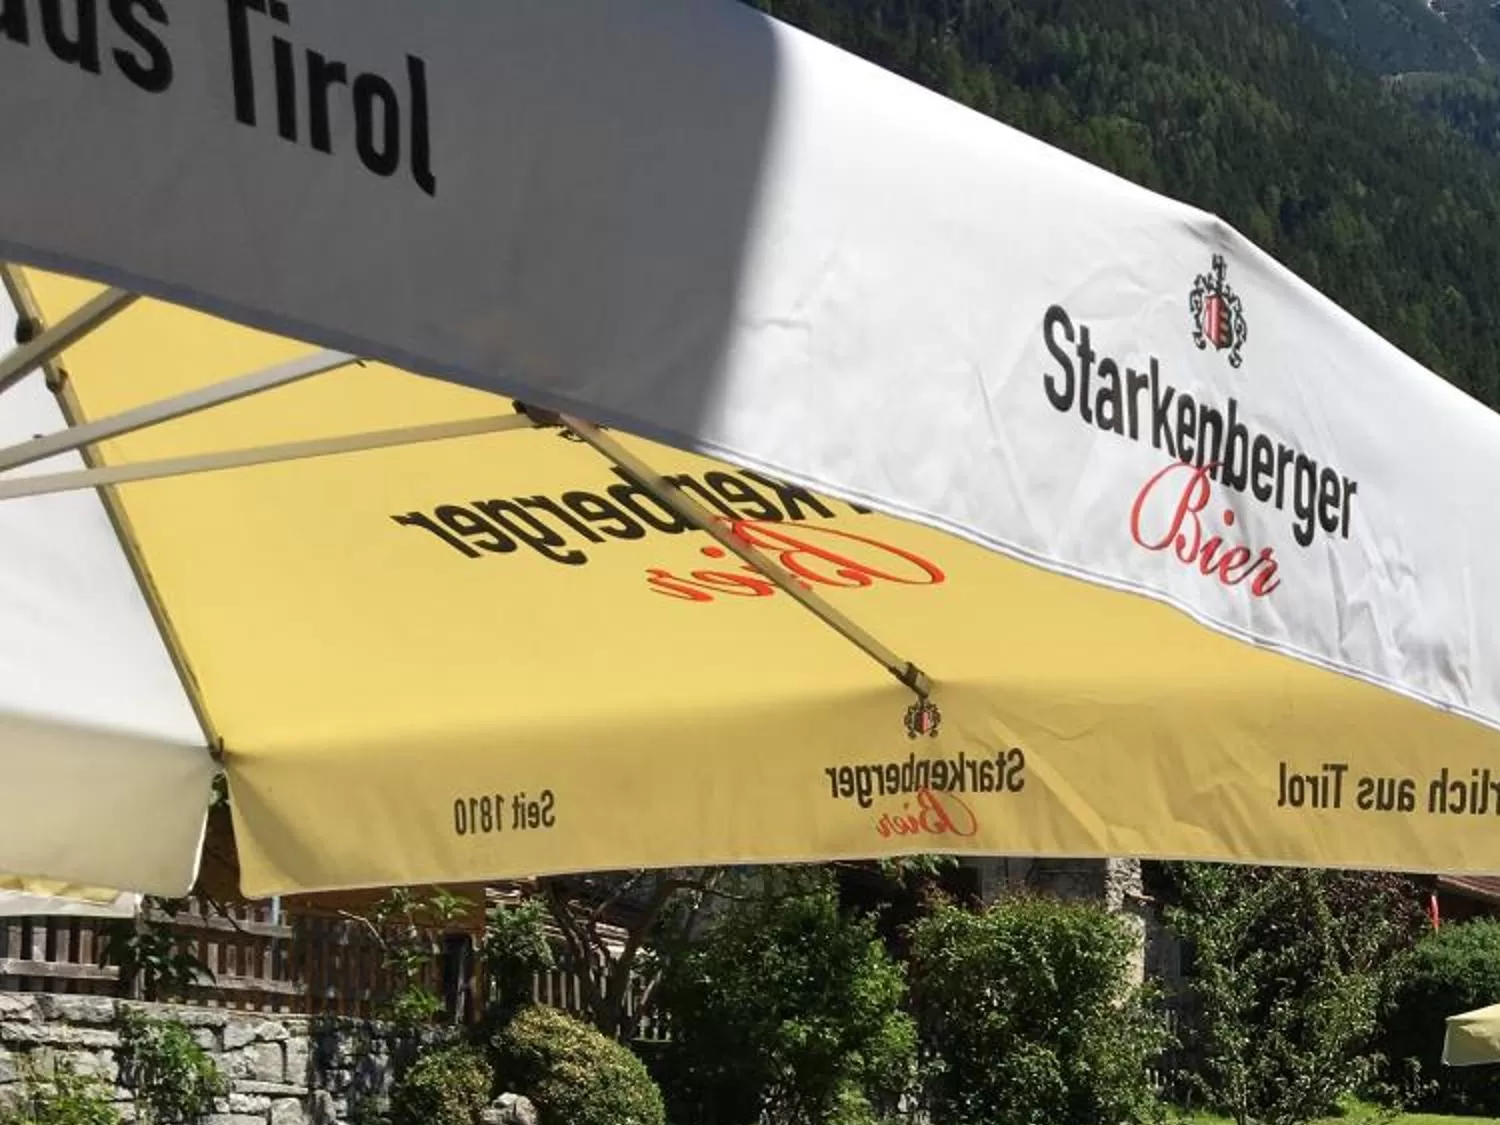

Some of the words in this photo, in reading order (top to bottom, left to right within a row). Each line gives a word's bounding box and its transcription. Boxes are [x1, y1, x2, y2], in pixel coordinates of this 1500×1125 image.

[226, 0, 437, 198] Tirol
[1042, 303, 1358, 548] Starkenberger
[1129, 461, 1281, 597] Bier
